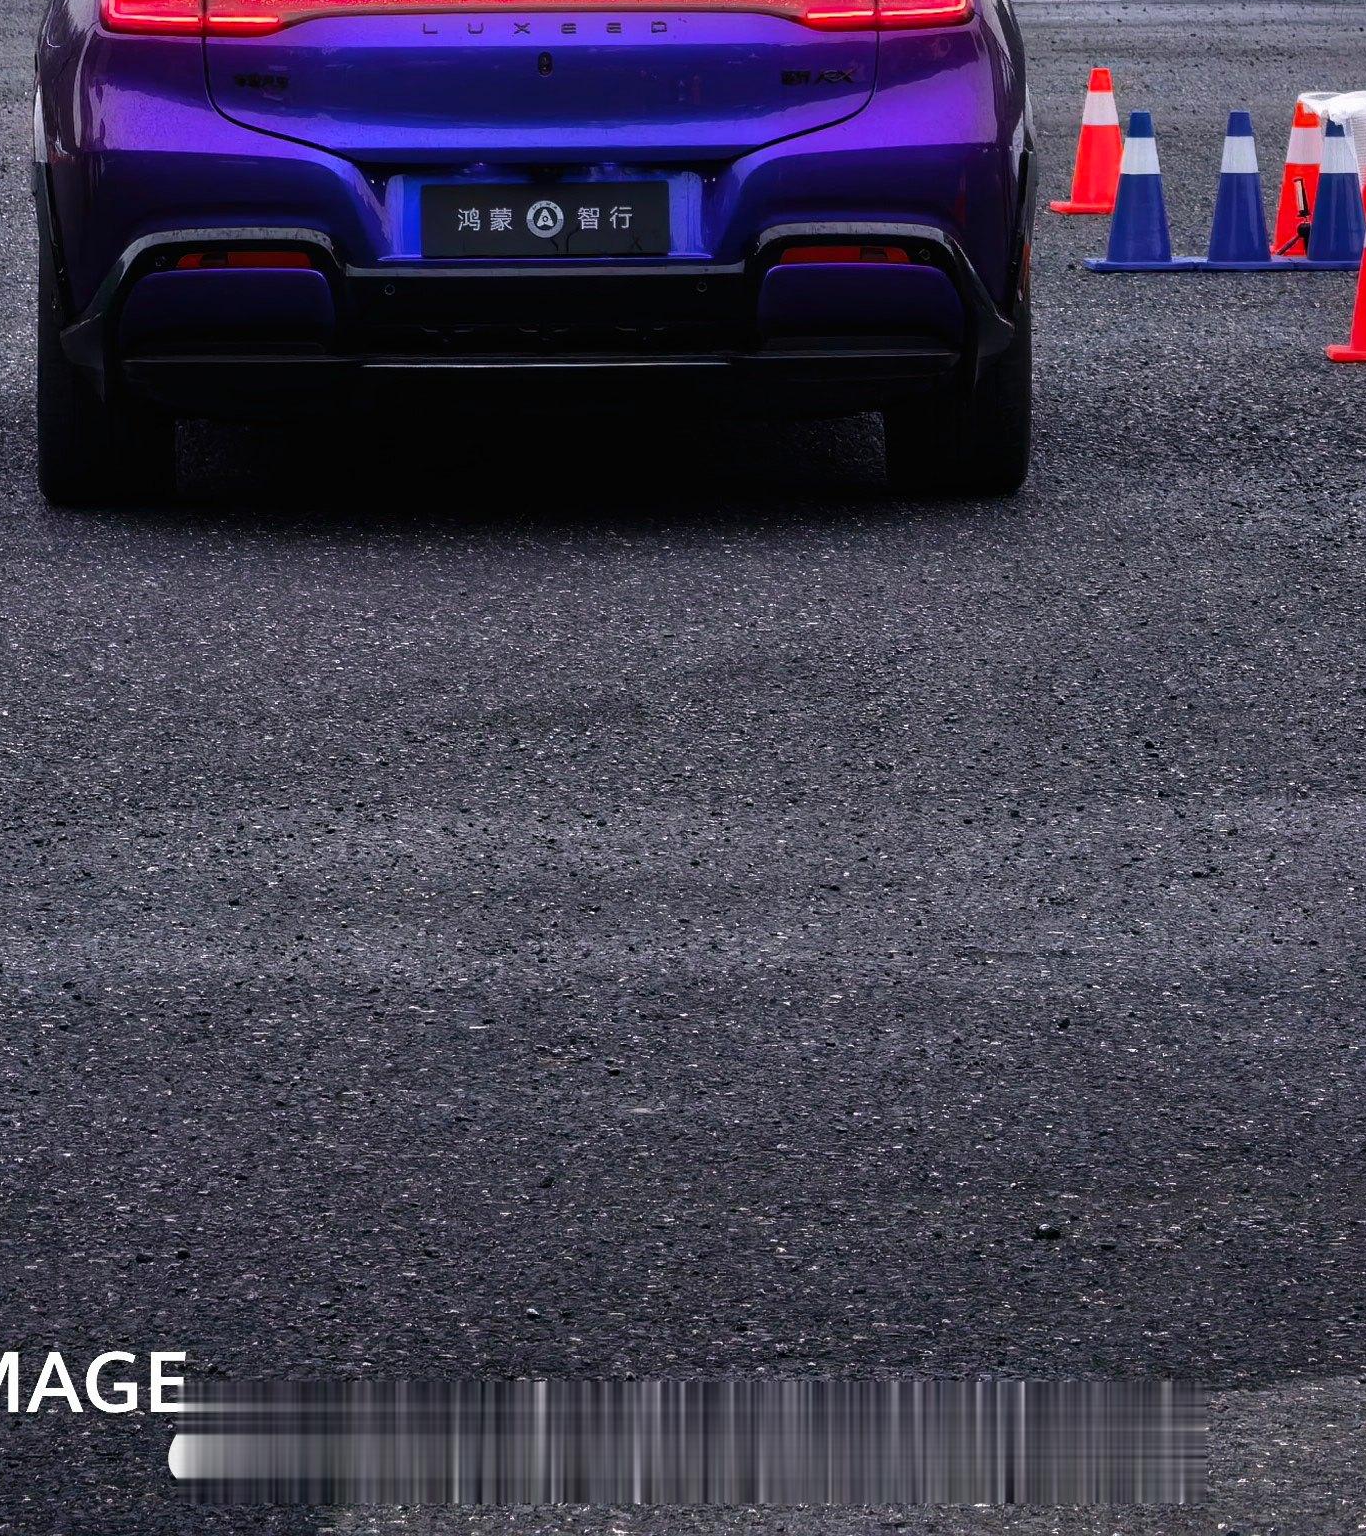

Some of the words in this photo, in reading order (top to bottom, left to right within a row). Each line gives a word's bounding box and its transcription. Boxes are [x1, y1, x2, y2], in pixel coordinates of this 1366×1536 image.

[422, 21, 669, 36] LUXEED
[457, 207, 514, 231] 鸿蒙
[577, 206, 633, 230] 智行
